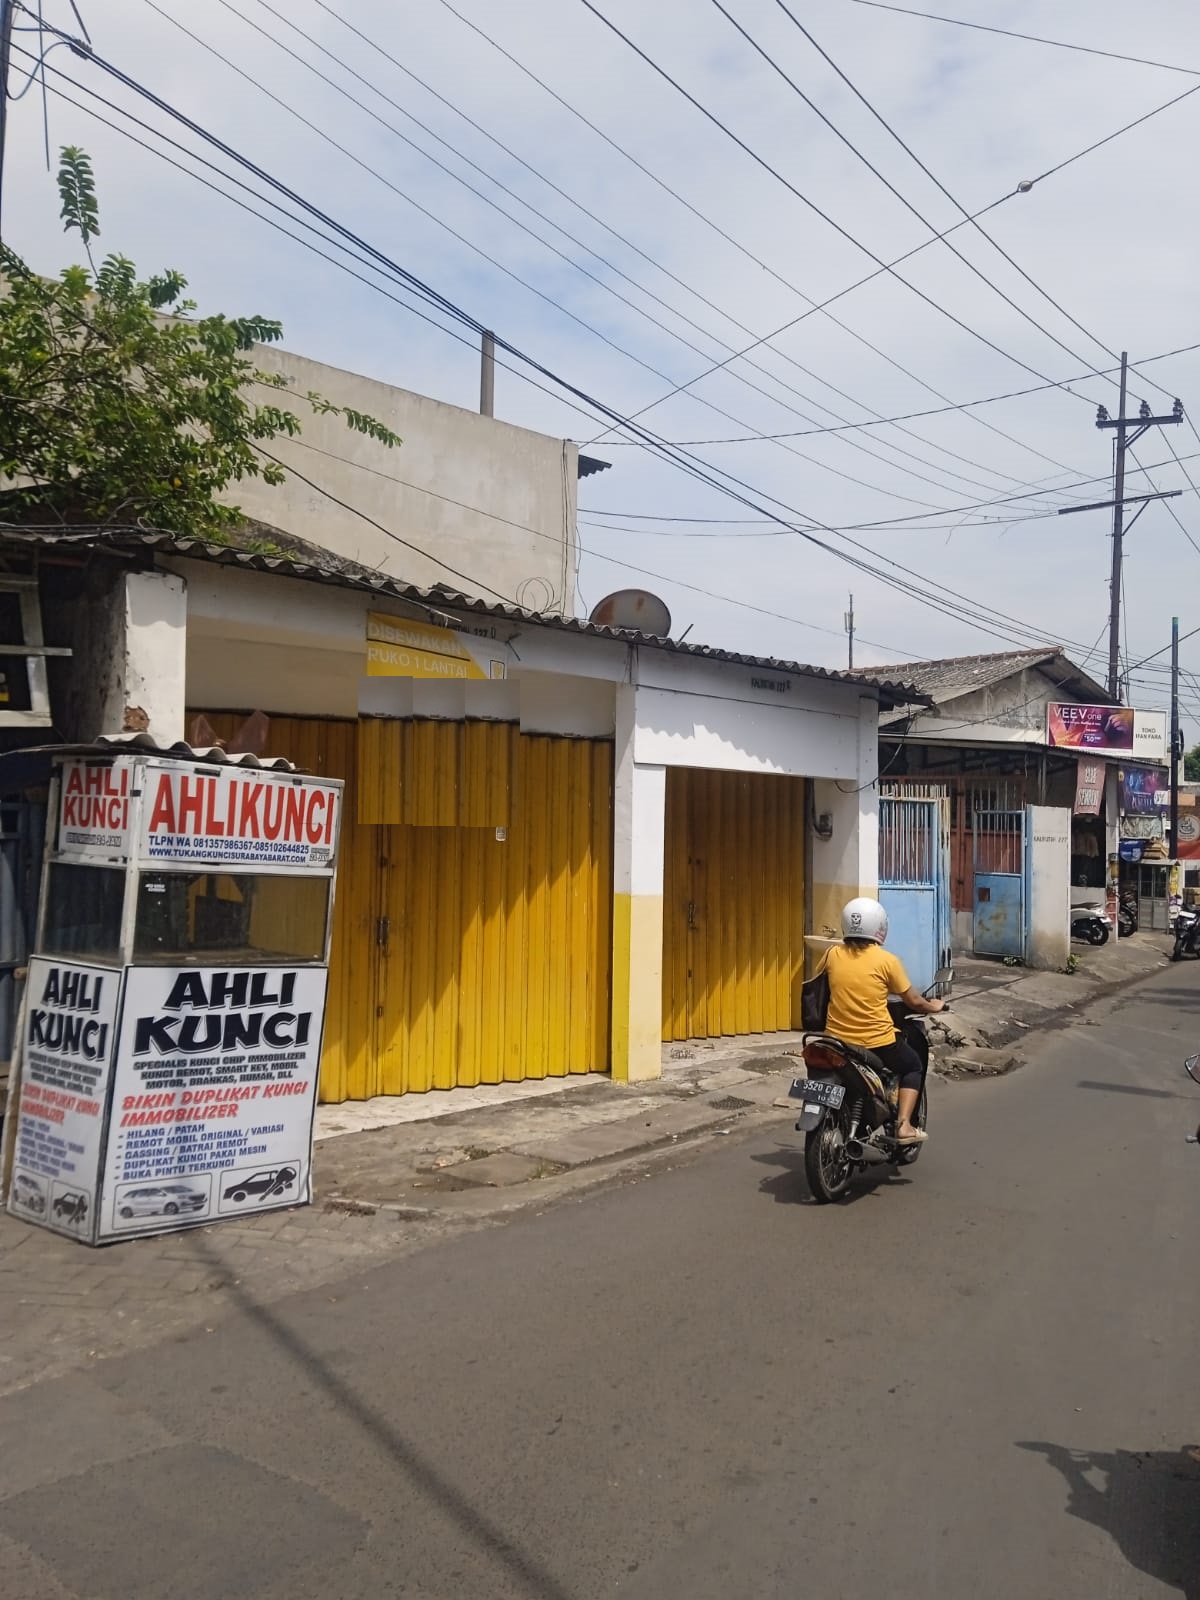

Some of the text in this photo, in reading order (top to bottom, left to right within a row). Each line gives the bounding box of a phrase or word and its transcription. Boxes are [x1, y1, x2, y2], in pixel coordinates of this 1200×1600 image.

[368, 647, 410, 666] RUKO
[423, 659, 467, 678] LANTAI
[1054, 708, 1087, 720] VEEV
[66, 767, 128, 796] AHLI
[63, 796, 129, 830] KUNCI
[149, 774, 335, 845] AHLIKUNCI
[149, 835, 173, 846] TLPN
[176, 837, 191, 847] WA
[149, 848, 306, 863] WWW.TUKANGKUNCISURABAYABARAT.COM
[41, 968, 103, 1014] AHLI
[162, 971, 297, 1012] AHLI
[28, 1008, 109, 1062] KUNCI
[132, 1011, 312, 1056] KUNCI
[141, 1068, 174, 1080] KUNCI
[215, 1064, 248, 1075] SMART
[271, 1061, 299, 1071] MOBIL
[189, 1056, 220, 1068] KUNCI
[222, 1054, 246, 1065] CHIP
[247, 1052, 306, 1063] IMMOBILIZER
[277, 1071, 293, 1079] DLL
[122, 1092, 177, 1111] BIKIN
[180, 1085, 261, 1106] DUPLIKAT
[262, 1082, 309, 1099] KUNCI
[120, 1103, 239, 1128] IMMOBILIZER
[125, 1137, 163, 1150] REMOT
[166, 1134, 198, 1146] MOBIL
[200, 1129, 243, 1142] ORIGINAL
[250, 1124, 285, 1136] VARIASI
[127, 1127, 165, 1140] HILANG
[174, 1124, 205, 1135] PATAH
[124, 1145, 267, 1171] DUPLIKAT KUNCI PAKAI MESIN
[179, 1141, 214, 1154] BATRAI
[215, 1138, 248, 1150] REMOT
[122, 1158, 235, 1181] BUKA PINTU TERKUNCI
